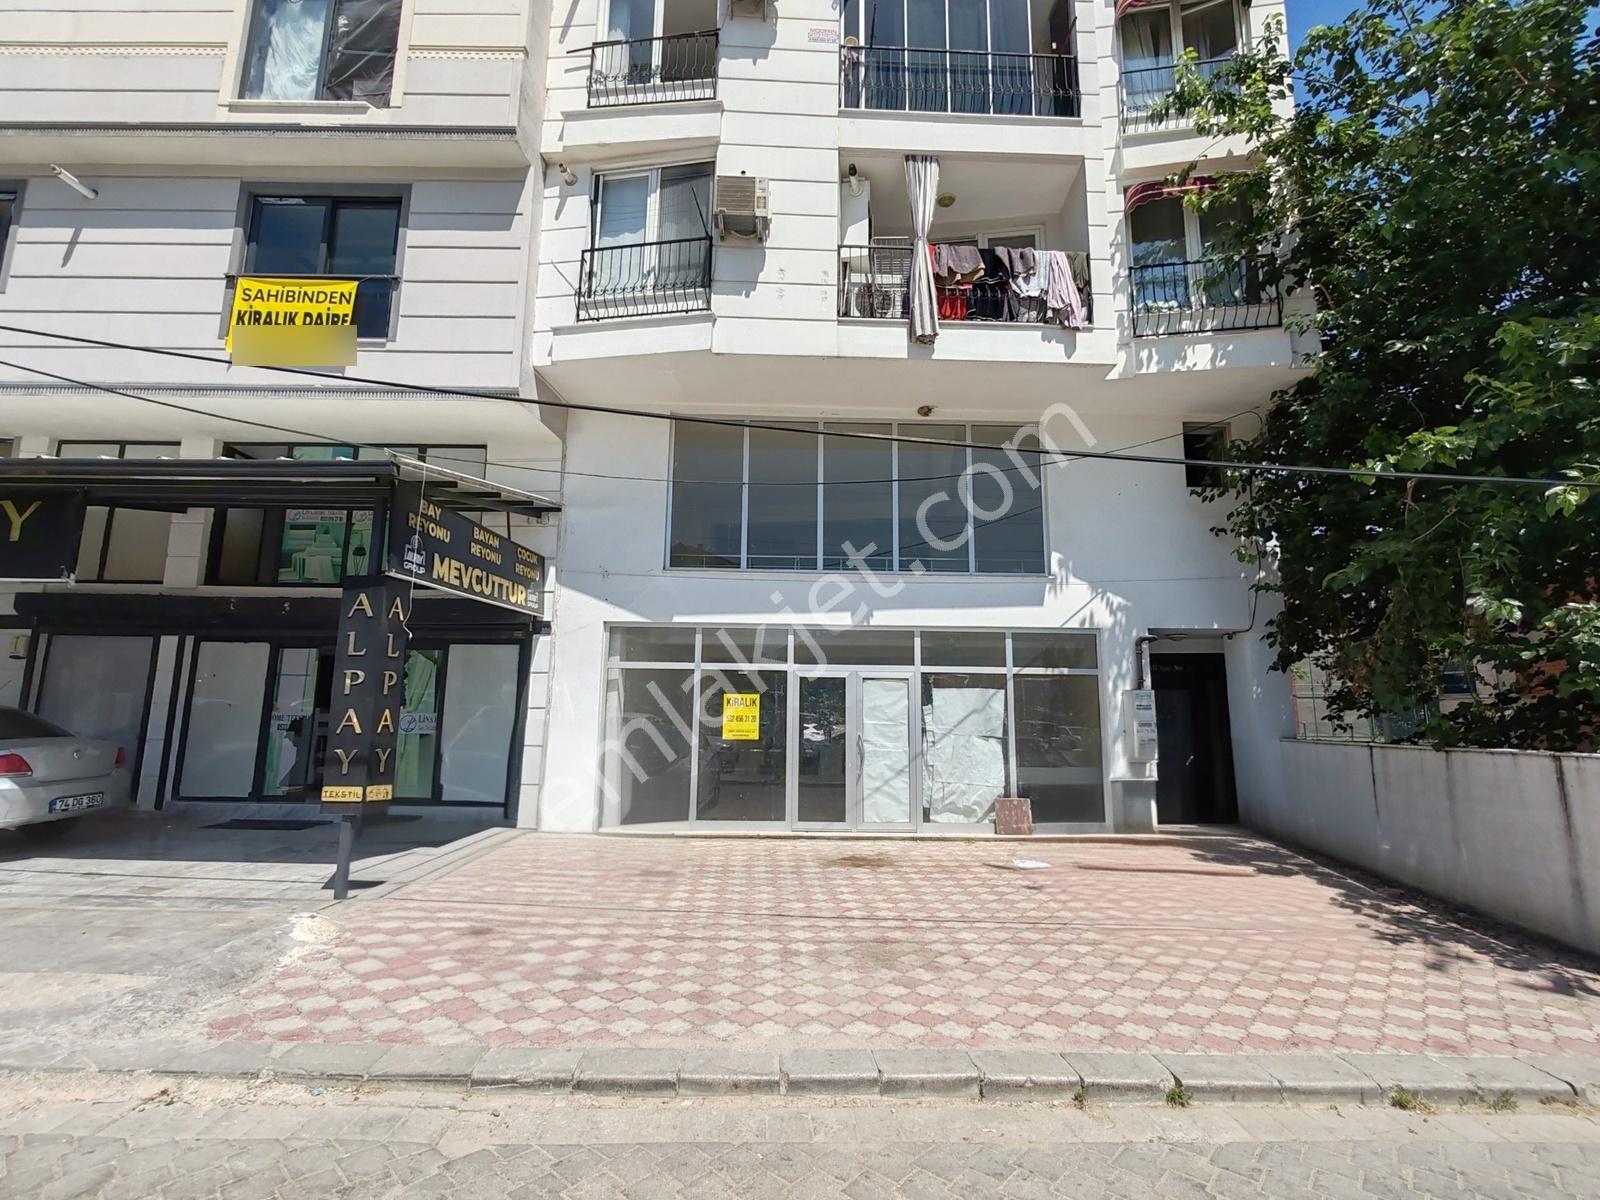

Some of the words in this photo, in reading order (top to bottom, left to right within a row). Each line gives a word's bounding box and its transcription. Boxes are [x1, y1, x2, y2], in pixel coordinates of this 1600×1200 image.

[241, 286, 352, 305] SAHİBİNDEN
[235, 305, 299, 326] KİRALIK
[0, 500, 42, 541] Y
[420, 500, 442, 521] BAY
[408, 512, 451, 544] REYONU
[473, 526, 500, 549] BAYAN
[470, 542, 502, 566] REYONU
[516, 547, 539, 565] ÇOCUK
[403, 561, 426, 575] GROUP
[432, 552, 526, 606] MEVCUTTUR
[515, 562, 540, 582] REYONU
[334, 593, 374, 775] ALPAY
[376, 597, 404, 773] ALPAY
